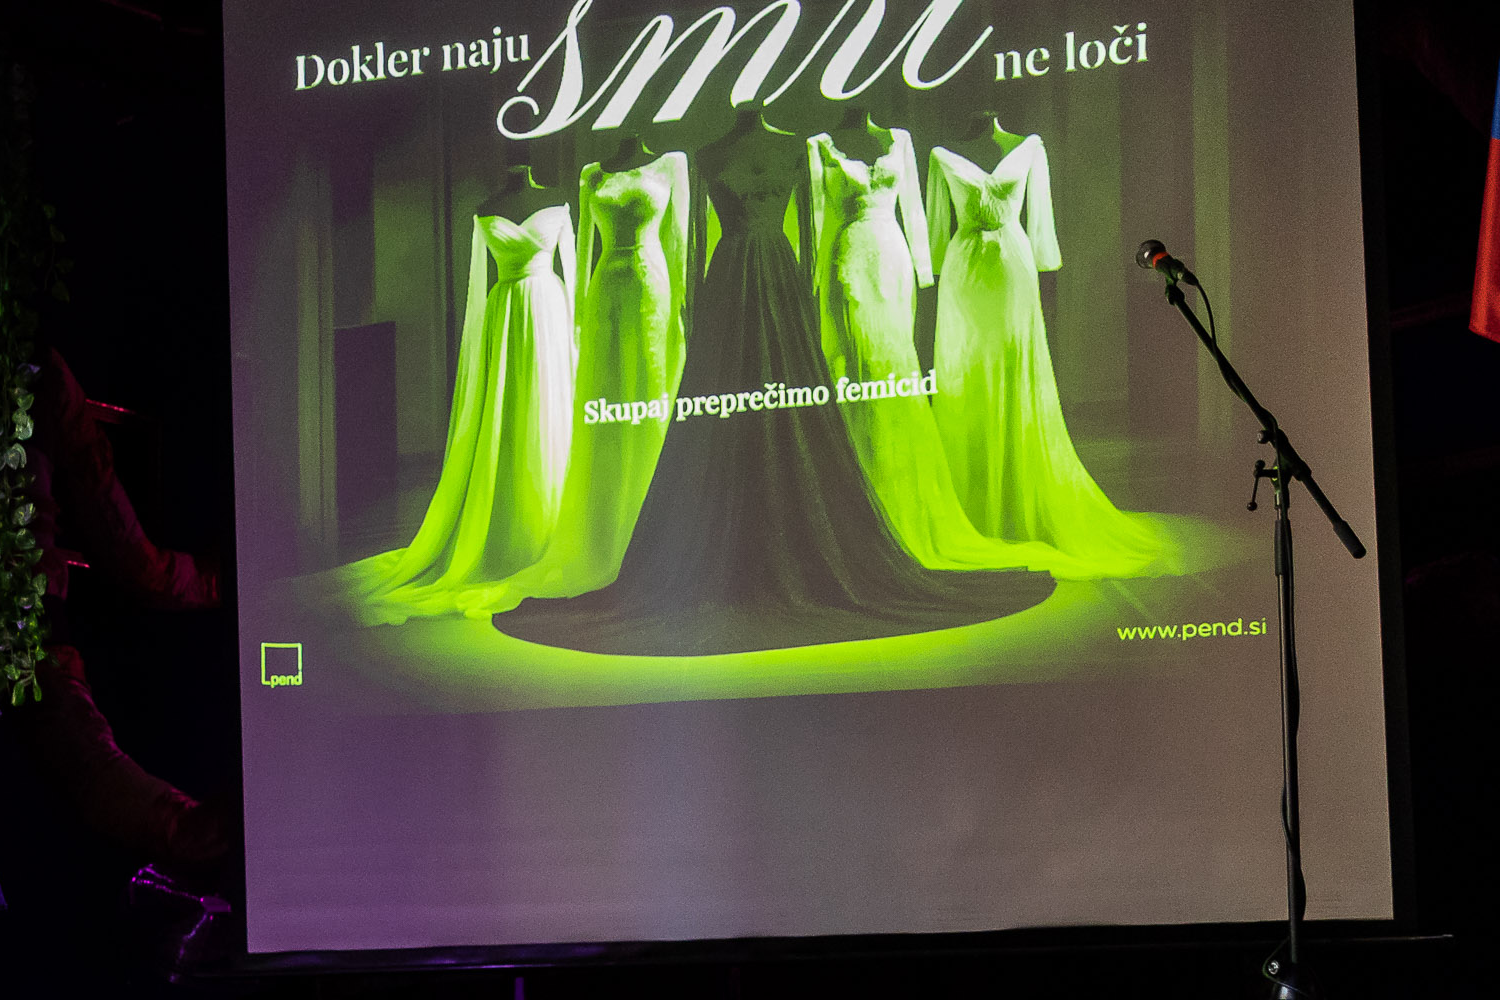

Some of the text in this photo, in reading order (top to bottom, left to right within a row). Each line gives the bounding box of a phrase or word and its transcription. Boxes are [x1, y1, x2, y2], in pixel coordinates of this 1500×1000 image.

[295, 42, 431, 91] Dokler
[442, 26, 530, 74] naju
[994, 47, 1050, 81] ne
[1065, 22, 1148, 72] loči
[584, 369, 938, 424] Skupaj preprečimo femicid
[1117, 617, 1267, 640] www.pend.si
[270, 672, 302, 688] pend
